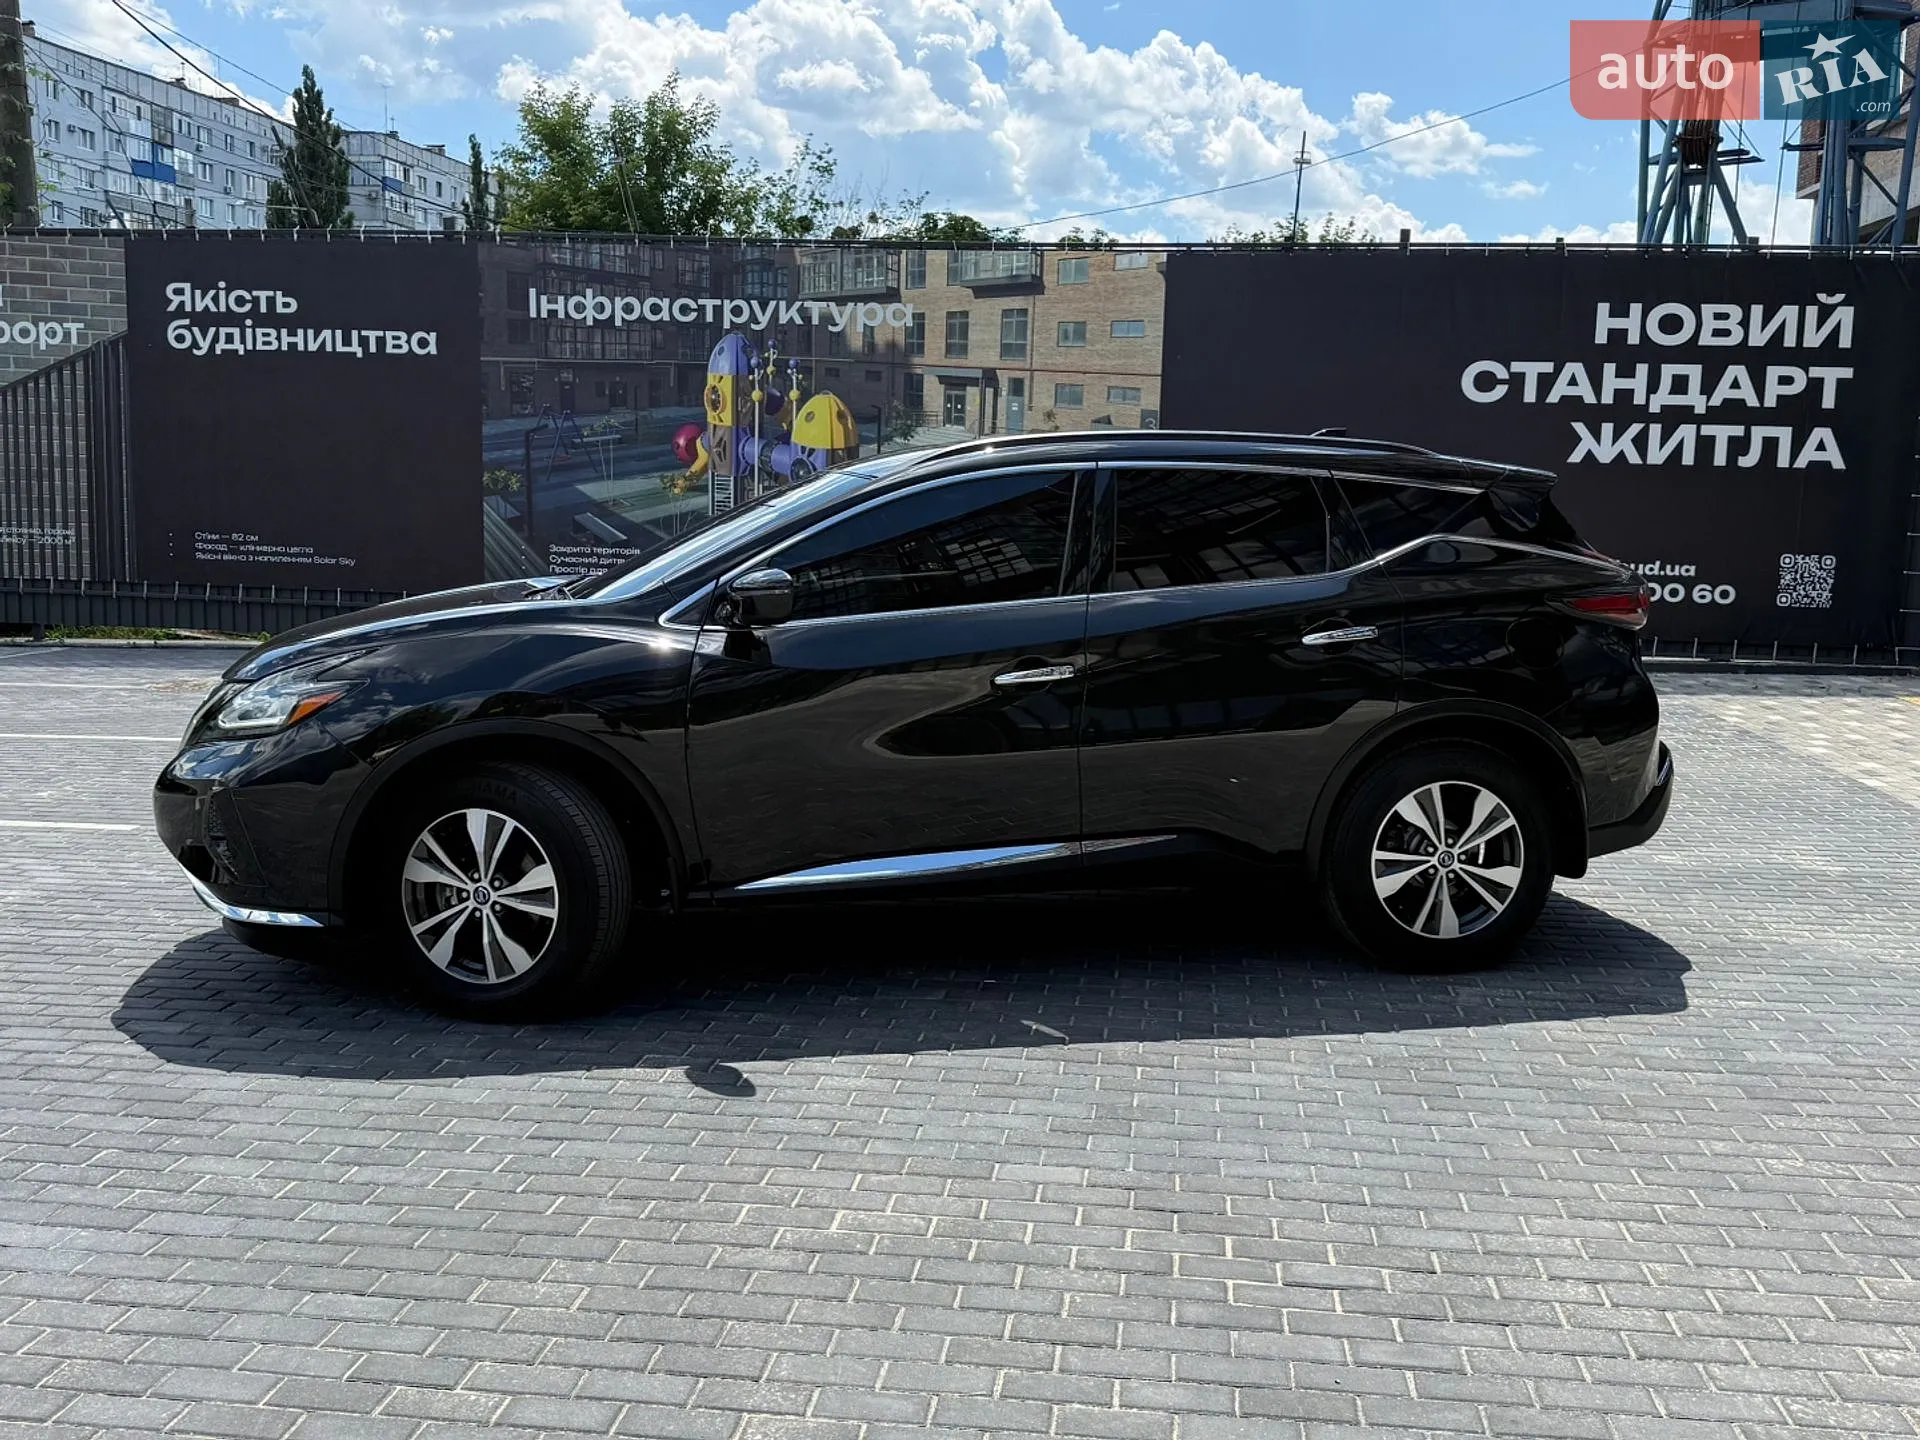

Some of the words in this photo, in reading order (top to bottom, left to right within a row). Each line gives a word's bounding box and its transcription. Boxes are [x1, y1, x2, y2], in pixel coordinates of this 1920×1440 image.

[165, 281, 299, 314] Якість
[528, 287, 914, 332] Інфраструктура
[1594, 293, 1855, 348] НОВИЙ
[166, 319, 438, 358] будівництва
[1460, 360, 1854, 414] СТАНДАРТ
[1566, 422, 1847, 470] ЖИТЛА
[194, 532, 220, 540] Стіни
[549, 544, 591, 554] Закрита
[313, 556, 337, 564] Solar
[338, 557, 356, 567] Sky
[549, 555, 598, 564] Сучасний
[549, 565, 588, 574] Простір
[1692, 584, 1737, 604] 60
